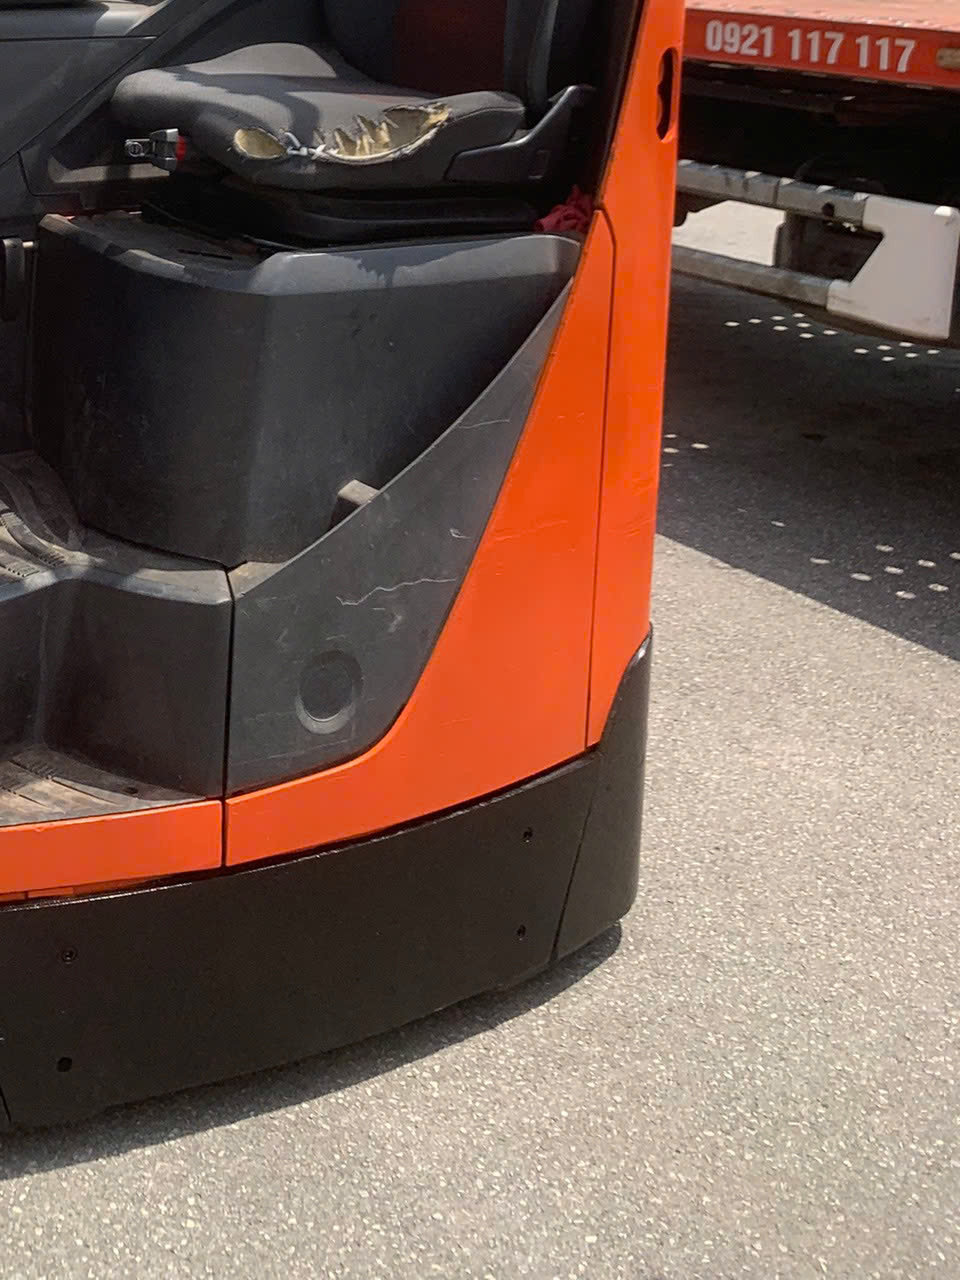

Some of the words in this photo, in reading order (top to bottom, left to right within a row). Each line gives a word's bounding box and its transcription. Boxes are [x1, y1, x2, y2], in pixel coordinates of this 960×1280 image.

[705, 19, 774, 58] 0921
[788, 28, 845, 65] 117
[855, 35, 916, 73] 117
